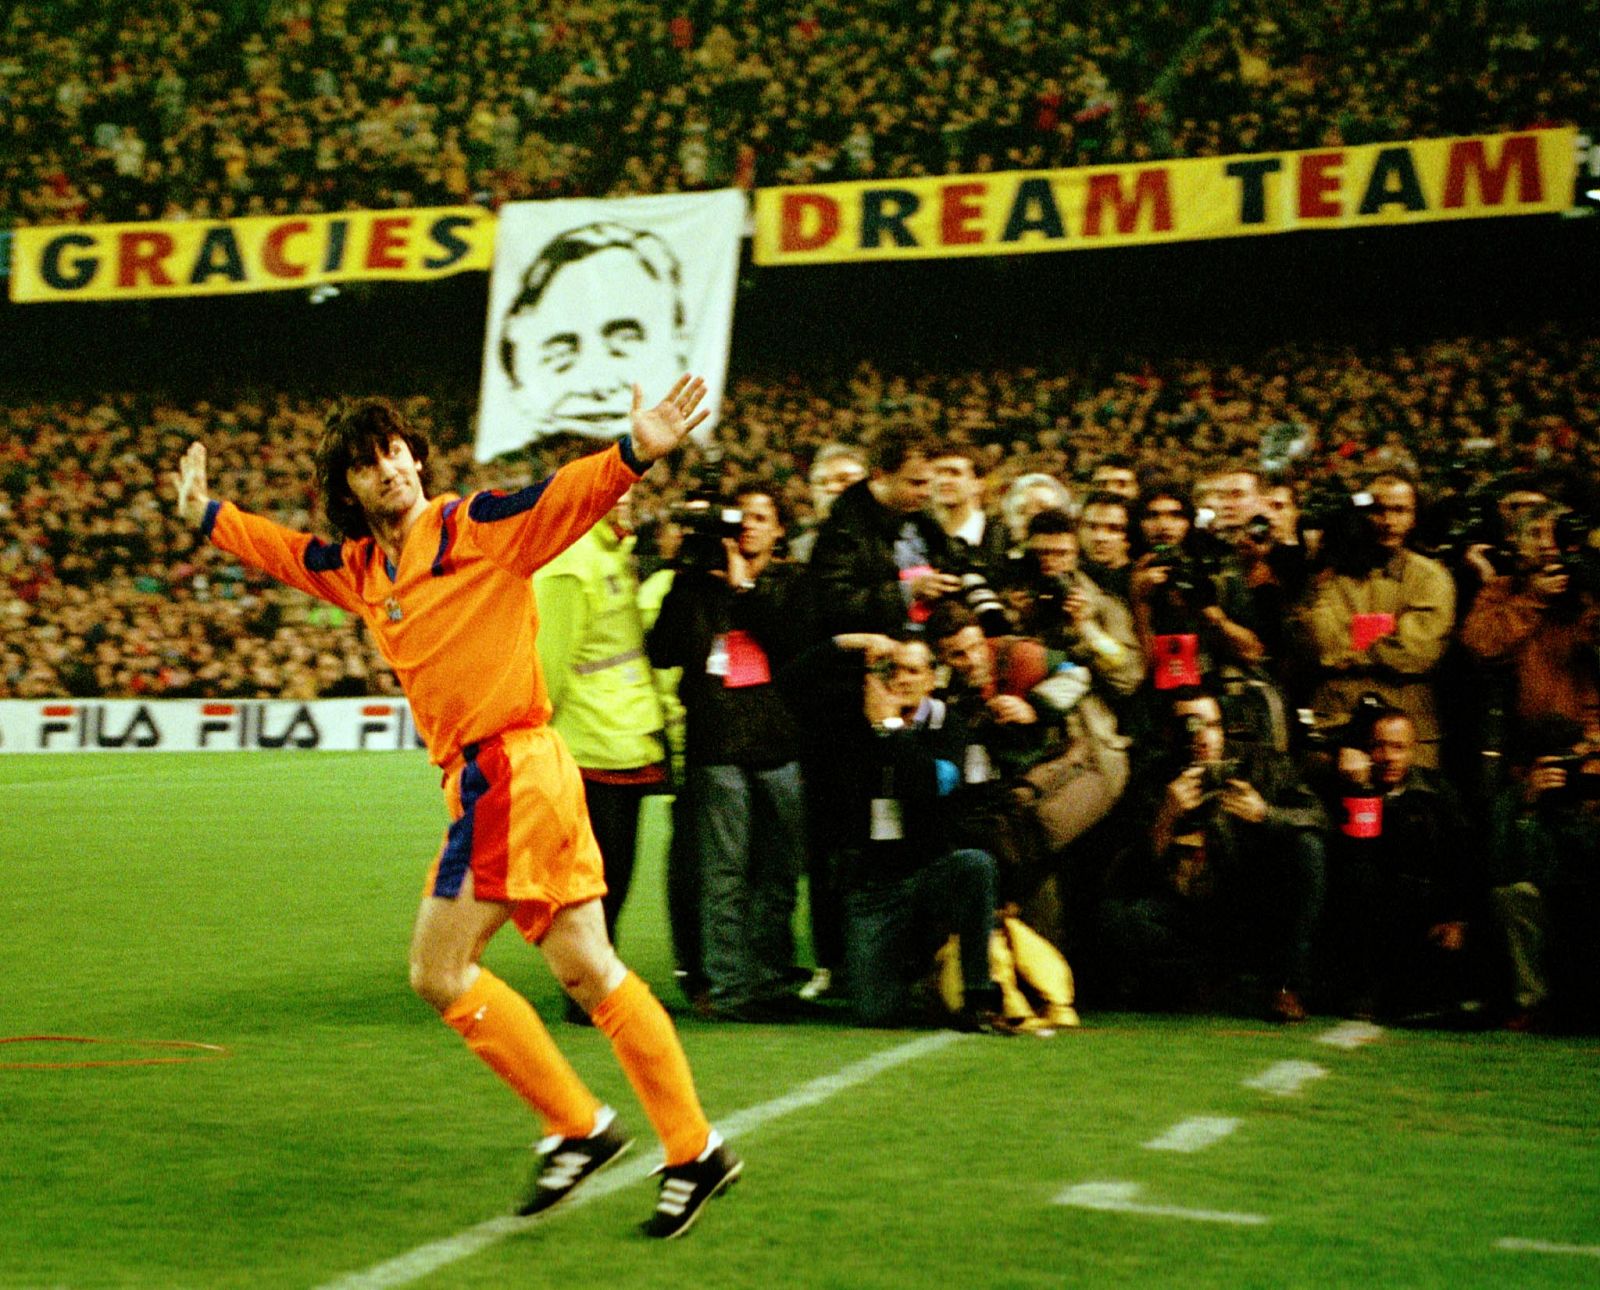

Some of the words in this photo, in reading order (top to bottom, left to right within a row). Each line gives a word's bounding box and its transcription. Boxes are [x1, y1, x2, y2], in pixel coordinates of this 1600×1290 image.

[780, 168, 1173, 252] DREAM
[1225, 136, 1543, 224] TEAM
[40, 215, 475, 290] GRACIES
[39, 705, 160, 748] FILA
[198, 704, 321, 748] FILA
